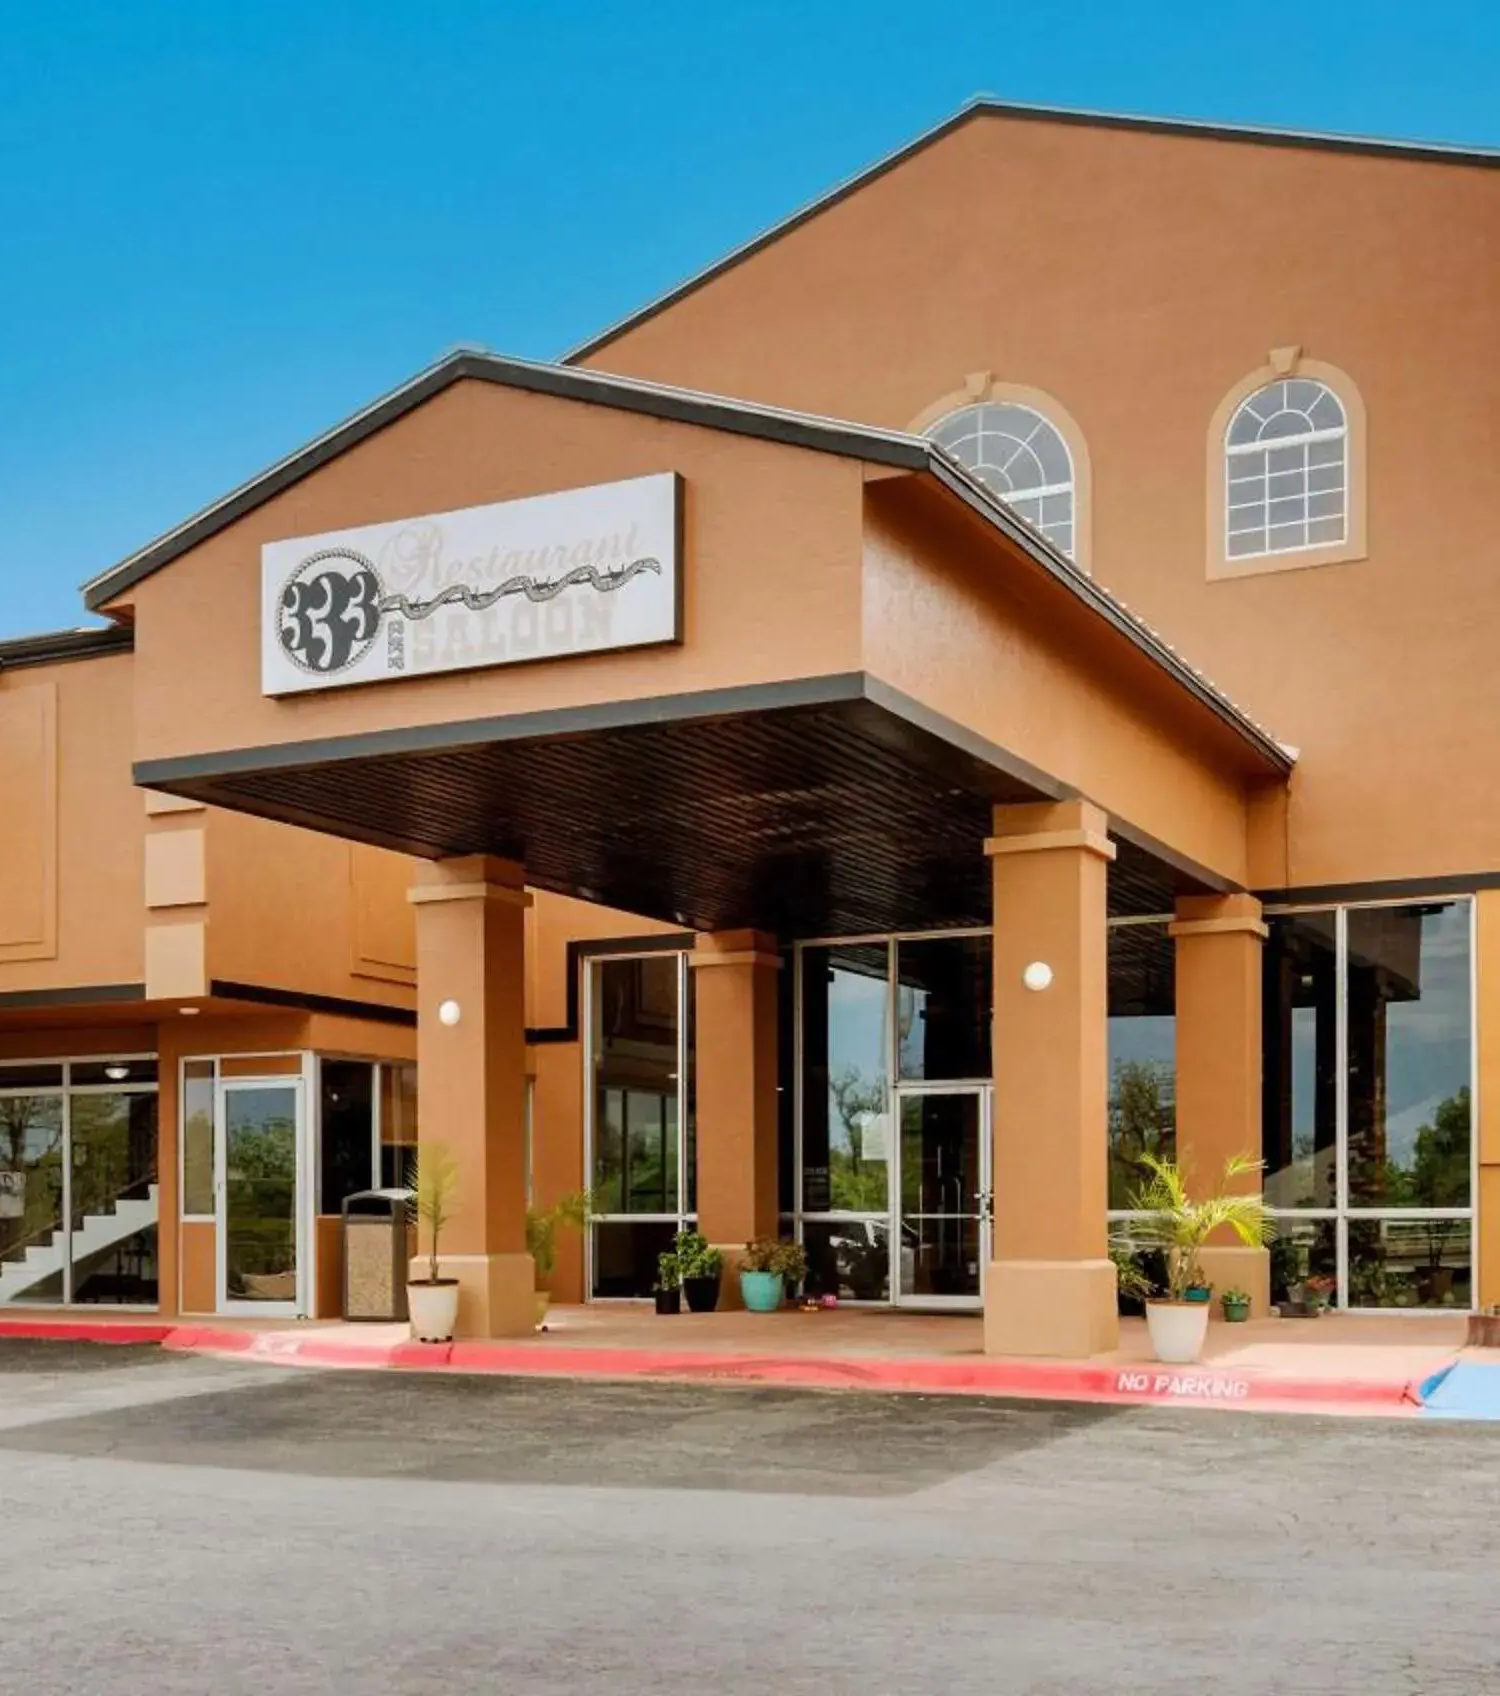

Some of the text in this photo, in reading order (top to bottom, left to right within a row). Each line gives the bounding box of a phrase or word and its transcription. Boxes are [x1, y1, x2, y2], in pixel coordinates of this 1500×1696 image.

[378, 520, 641, 591] Restaurant
[281, 571, 380, 672] 333
[412, 592, 617, 666] SALOON
[1118, 1374, 1248, 1397] NO PARKING
